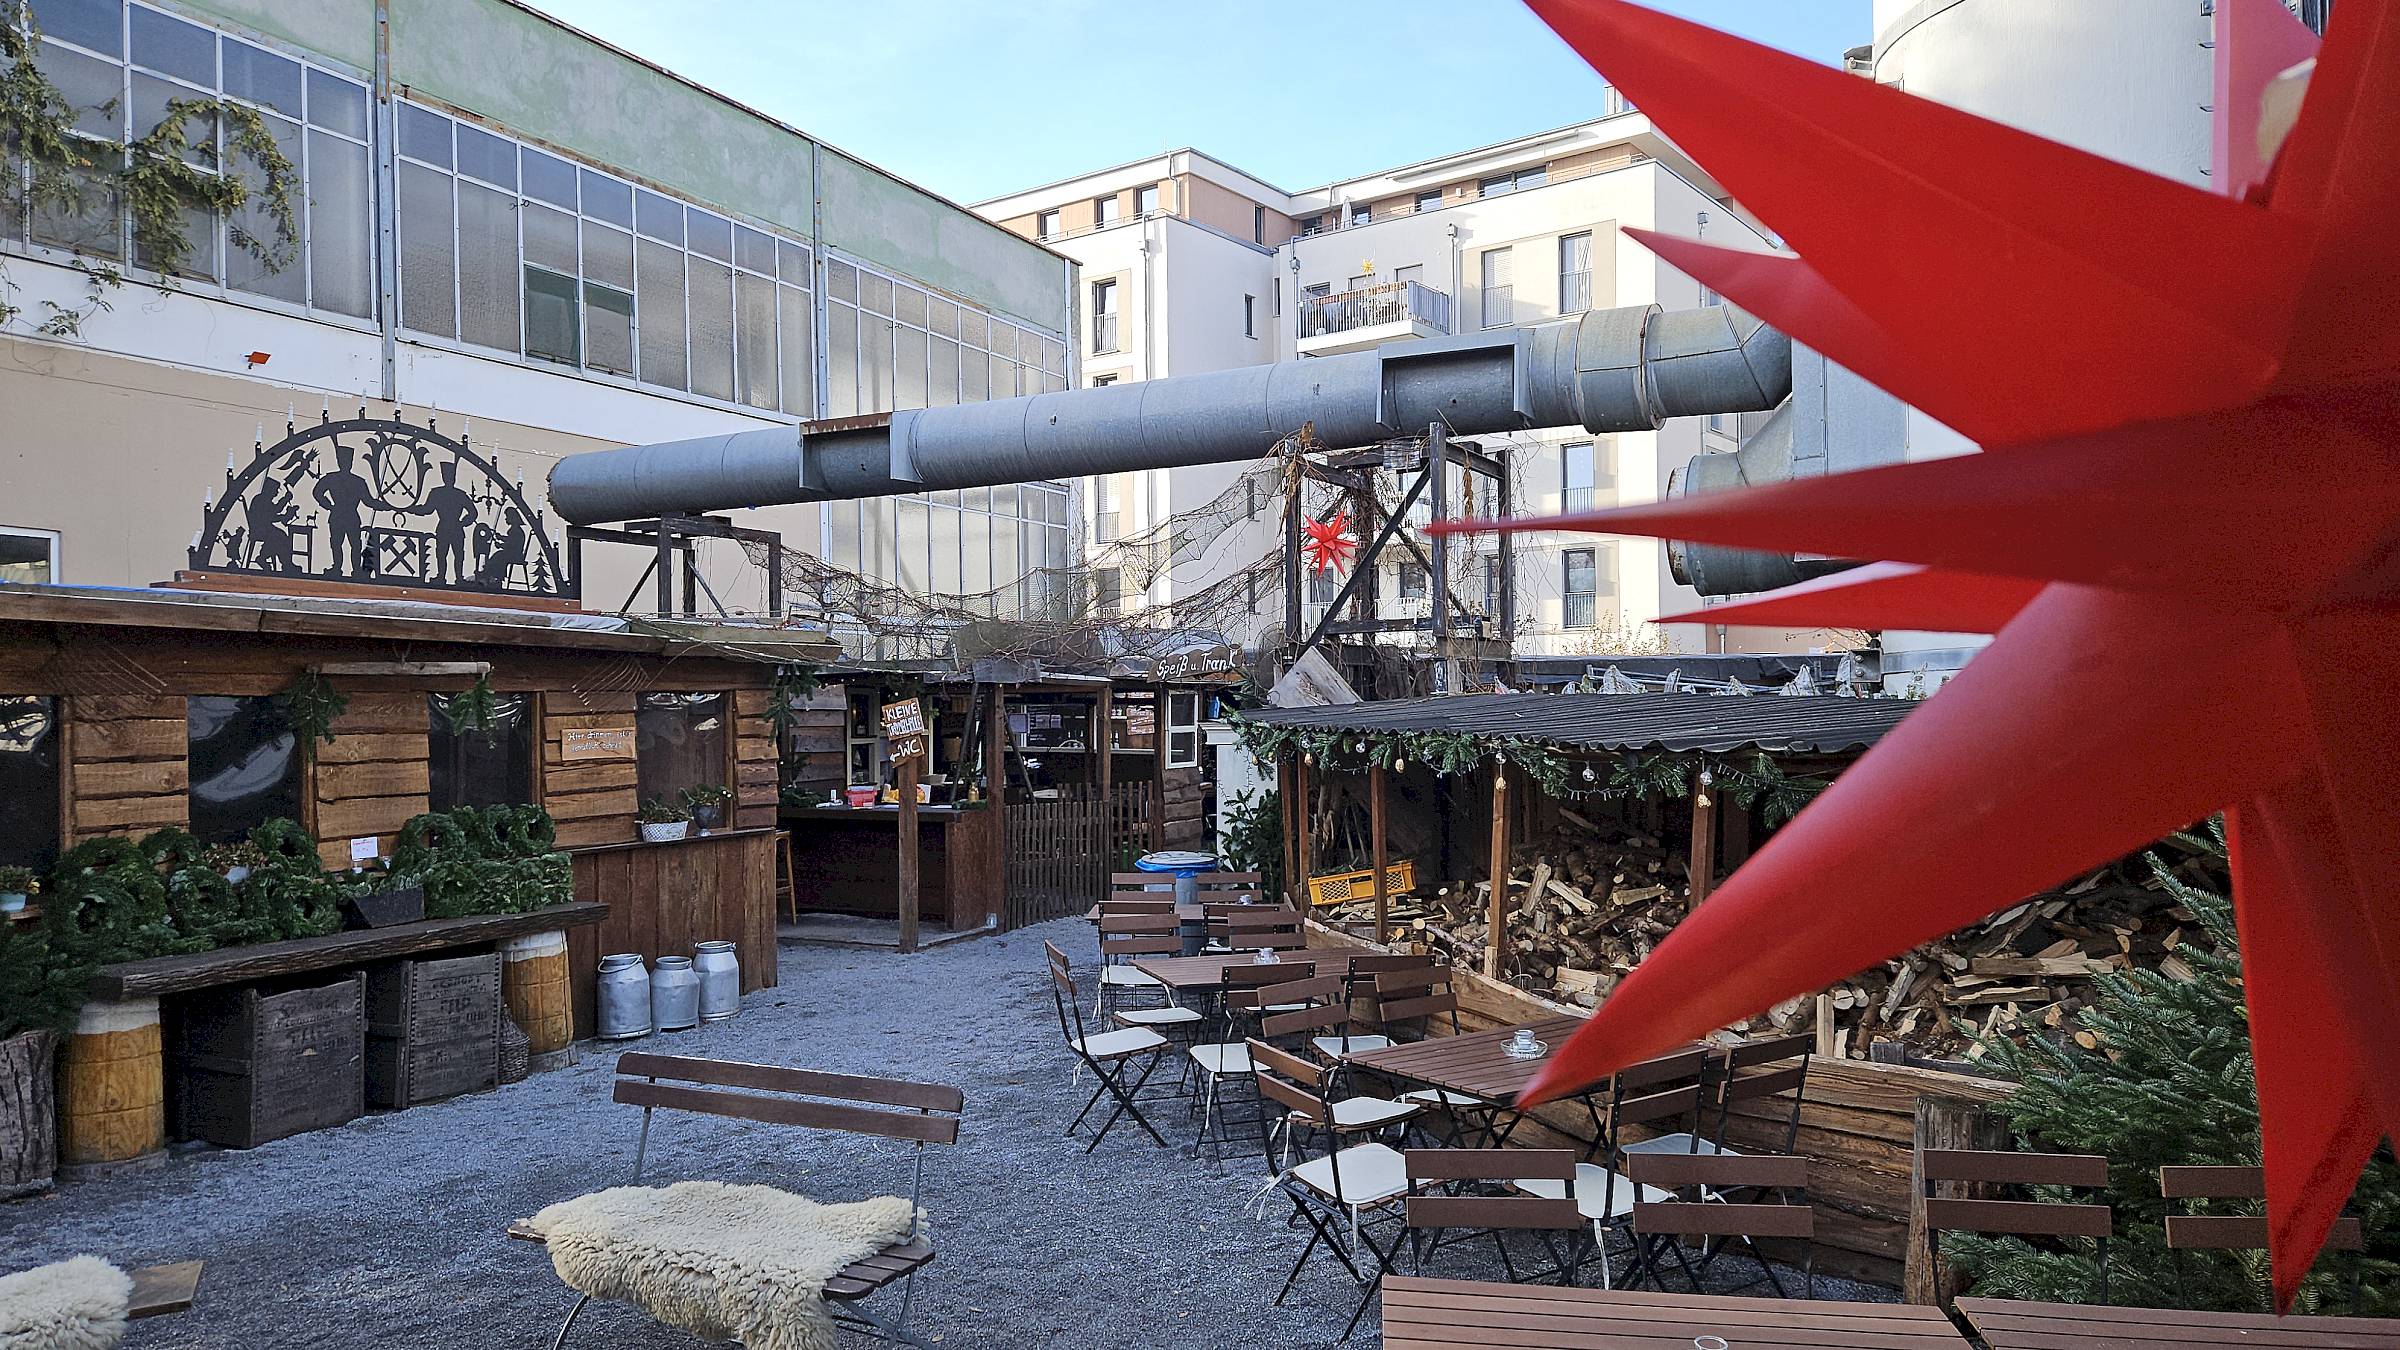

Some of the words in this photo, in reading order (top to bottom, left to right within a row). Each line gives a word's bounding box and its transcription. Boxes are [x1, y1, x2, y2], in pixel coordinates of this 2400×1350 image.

[1156, 655, 1189, 680] Speiß
[886, 702, 918, 722] KLEINE
[897, 739, 920, 757] WC
